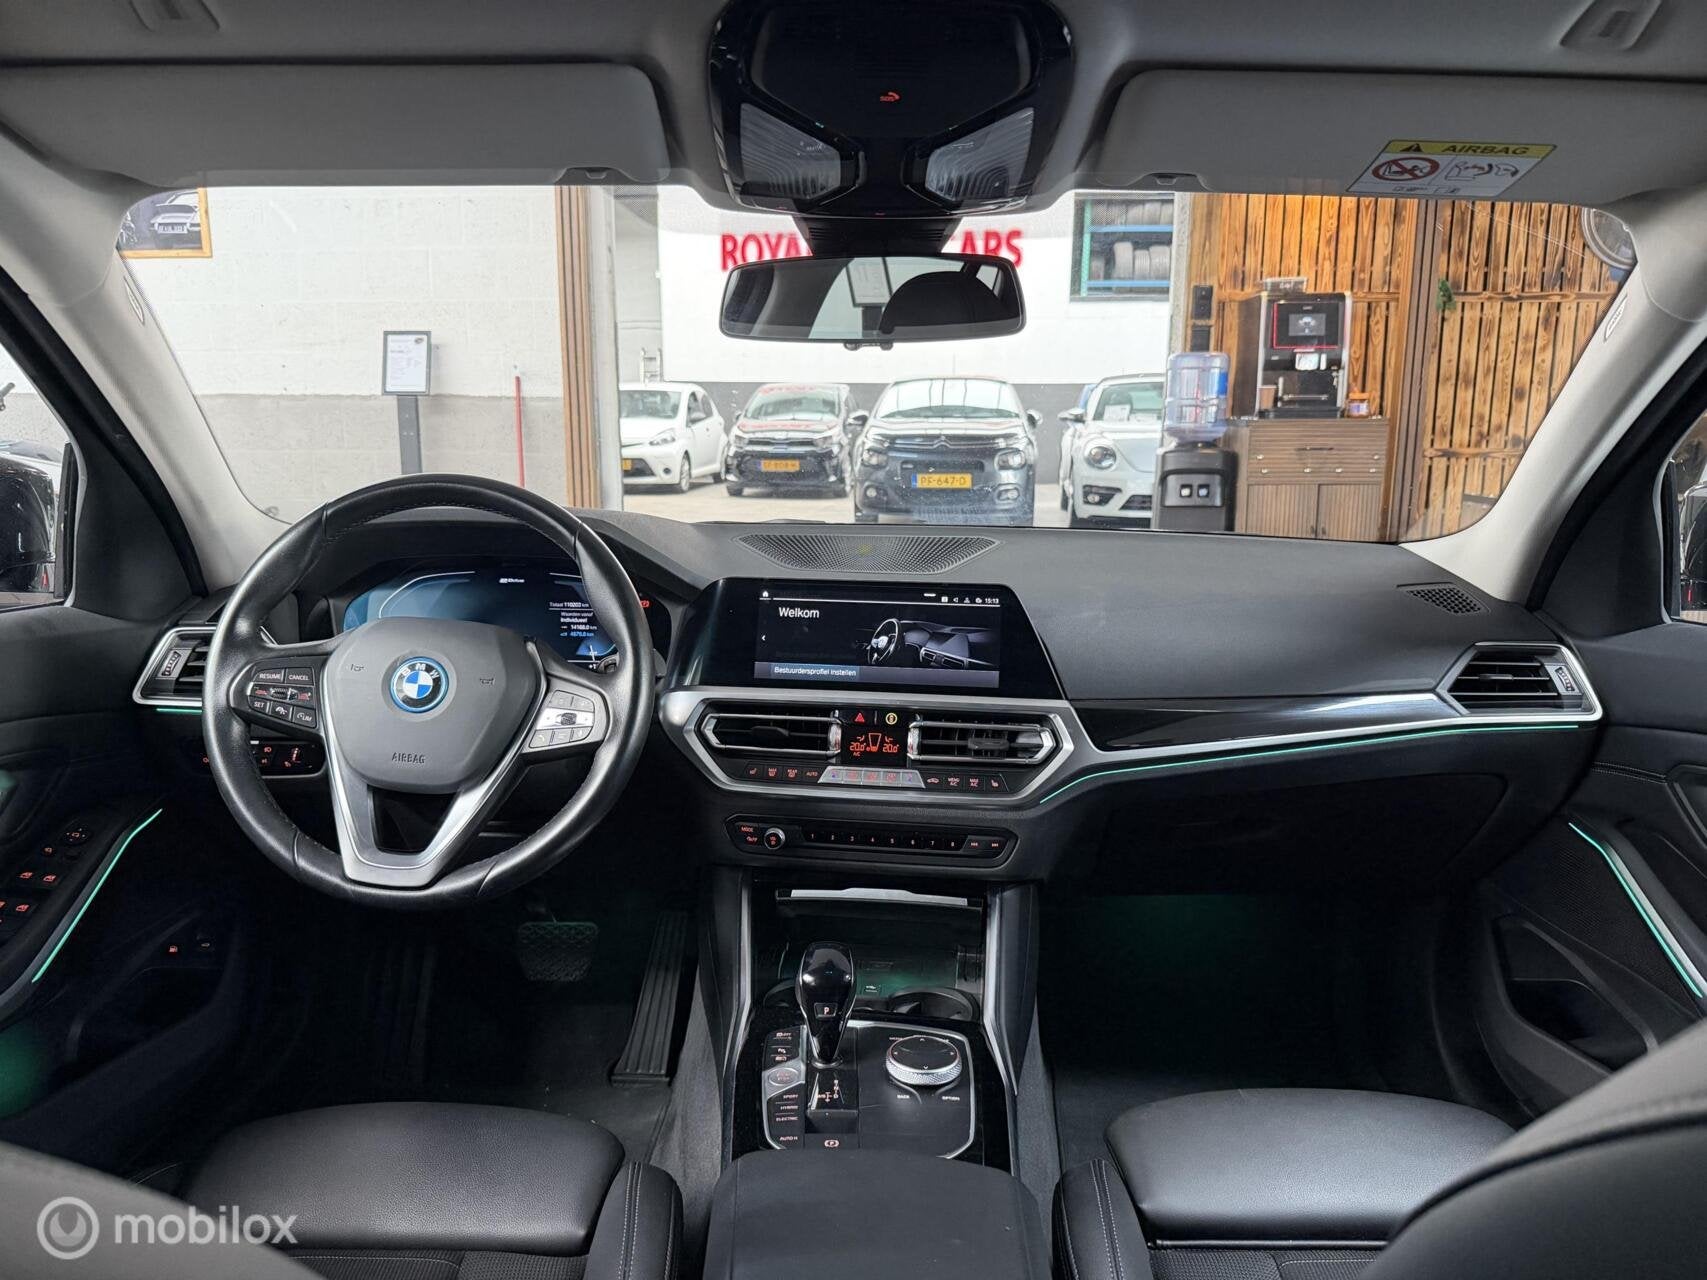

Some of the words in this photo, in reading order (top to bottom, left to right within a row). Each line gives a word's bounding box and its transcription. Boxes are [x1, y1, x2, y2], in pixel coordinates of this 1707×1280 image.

[1442, 144, 1530, 155] AIRBAG
[721, 233, 812, 271] ROYA
[949, 230, 1022, 267] ARS
[778, 607, 820, 619] Welkom
[401, 663, 440, 679] BMW
[774, 666, 829, 675] Bestuurdersprofiel
[391, 752, 425, 764] AIRBAG
[823, 1006, 830, 1015] P
